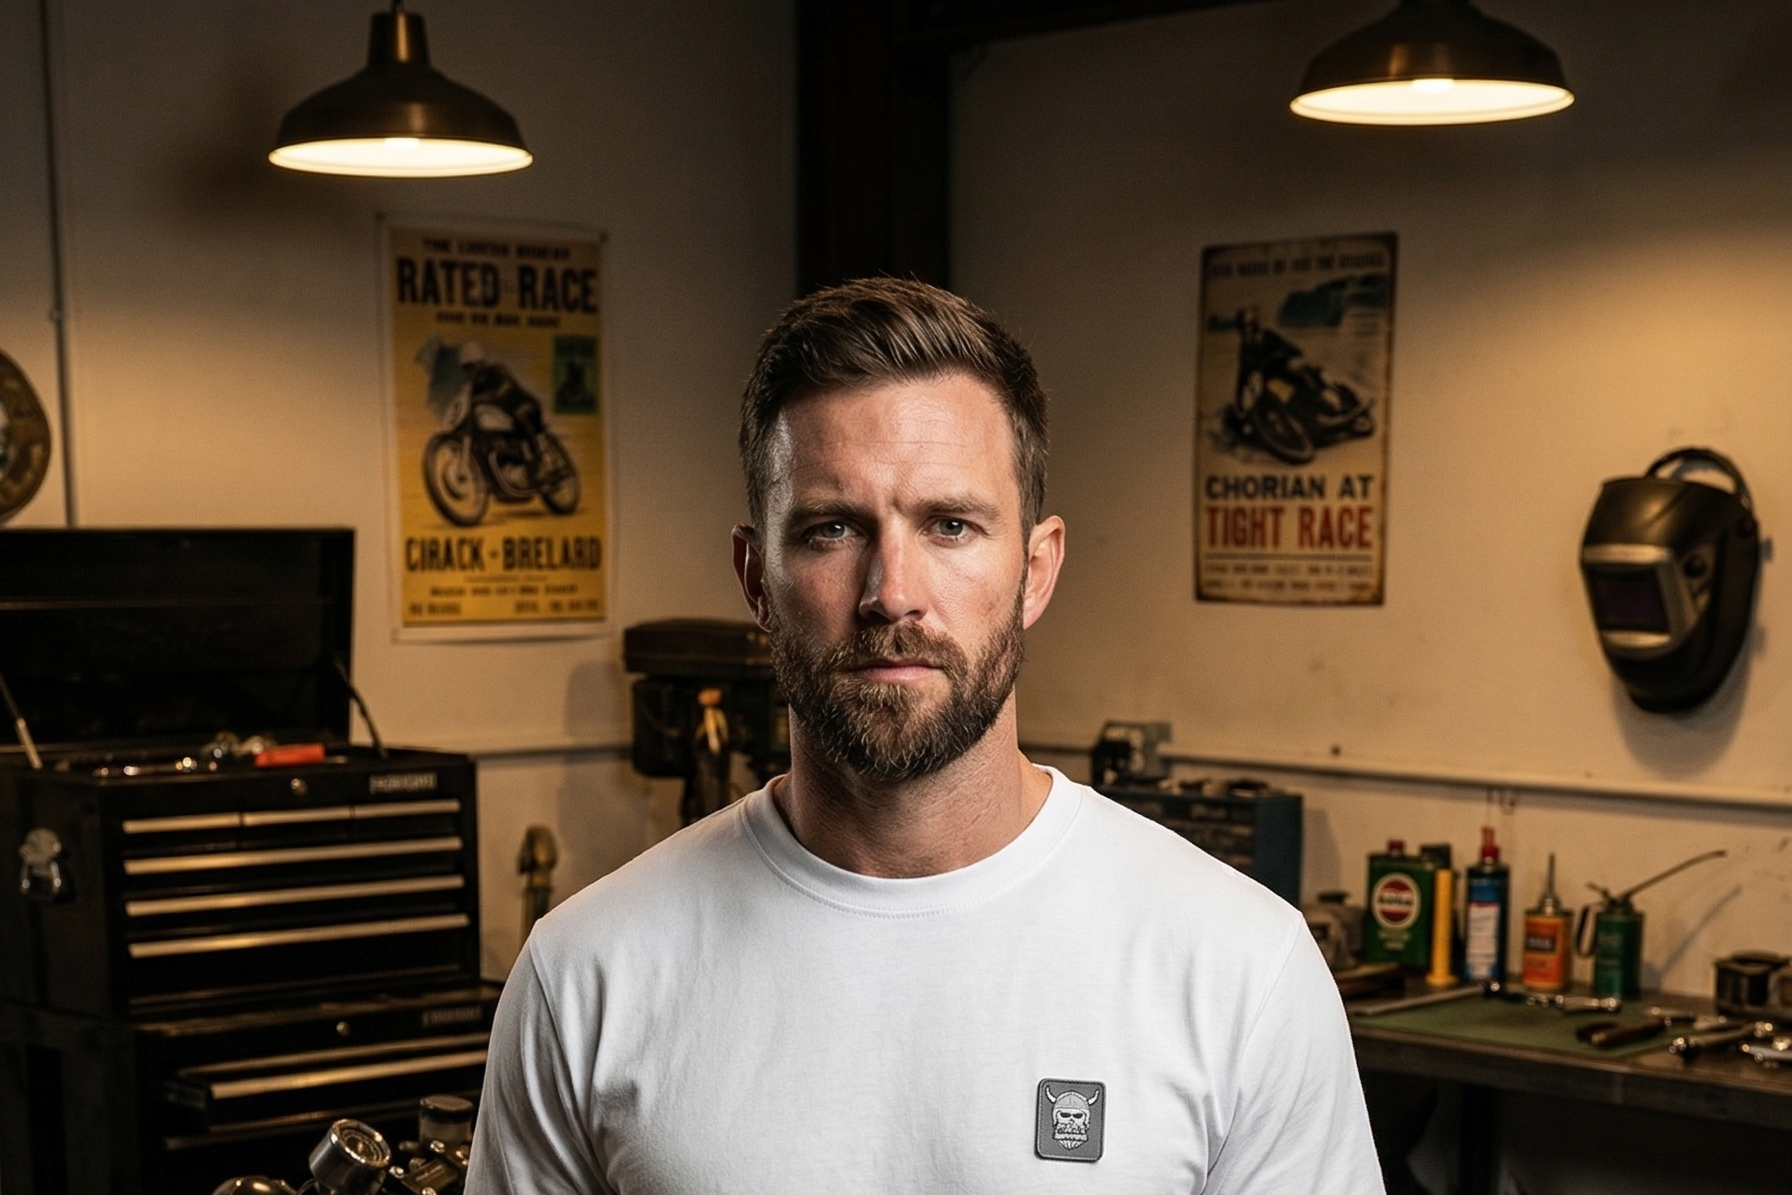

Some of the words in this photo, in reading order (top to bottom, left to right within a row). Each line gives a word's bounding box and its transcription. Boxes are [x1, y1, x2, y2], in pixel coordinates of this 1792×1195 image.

[397, 257, 499, 308] RATED
[518, 264, 598, 315] RACE
[1206, 475, 1326, 499] CHORIAN
[1339, 474, 1373, 499] AT
[1208, 505, 1285, 549] TIGHT
[1299, 505, 1372, 549] RACE
